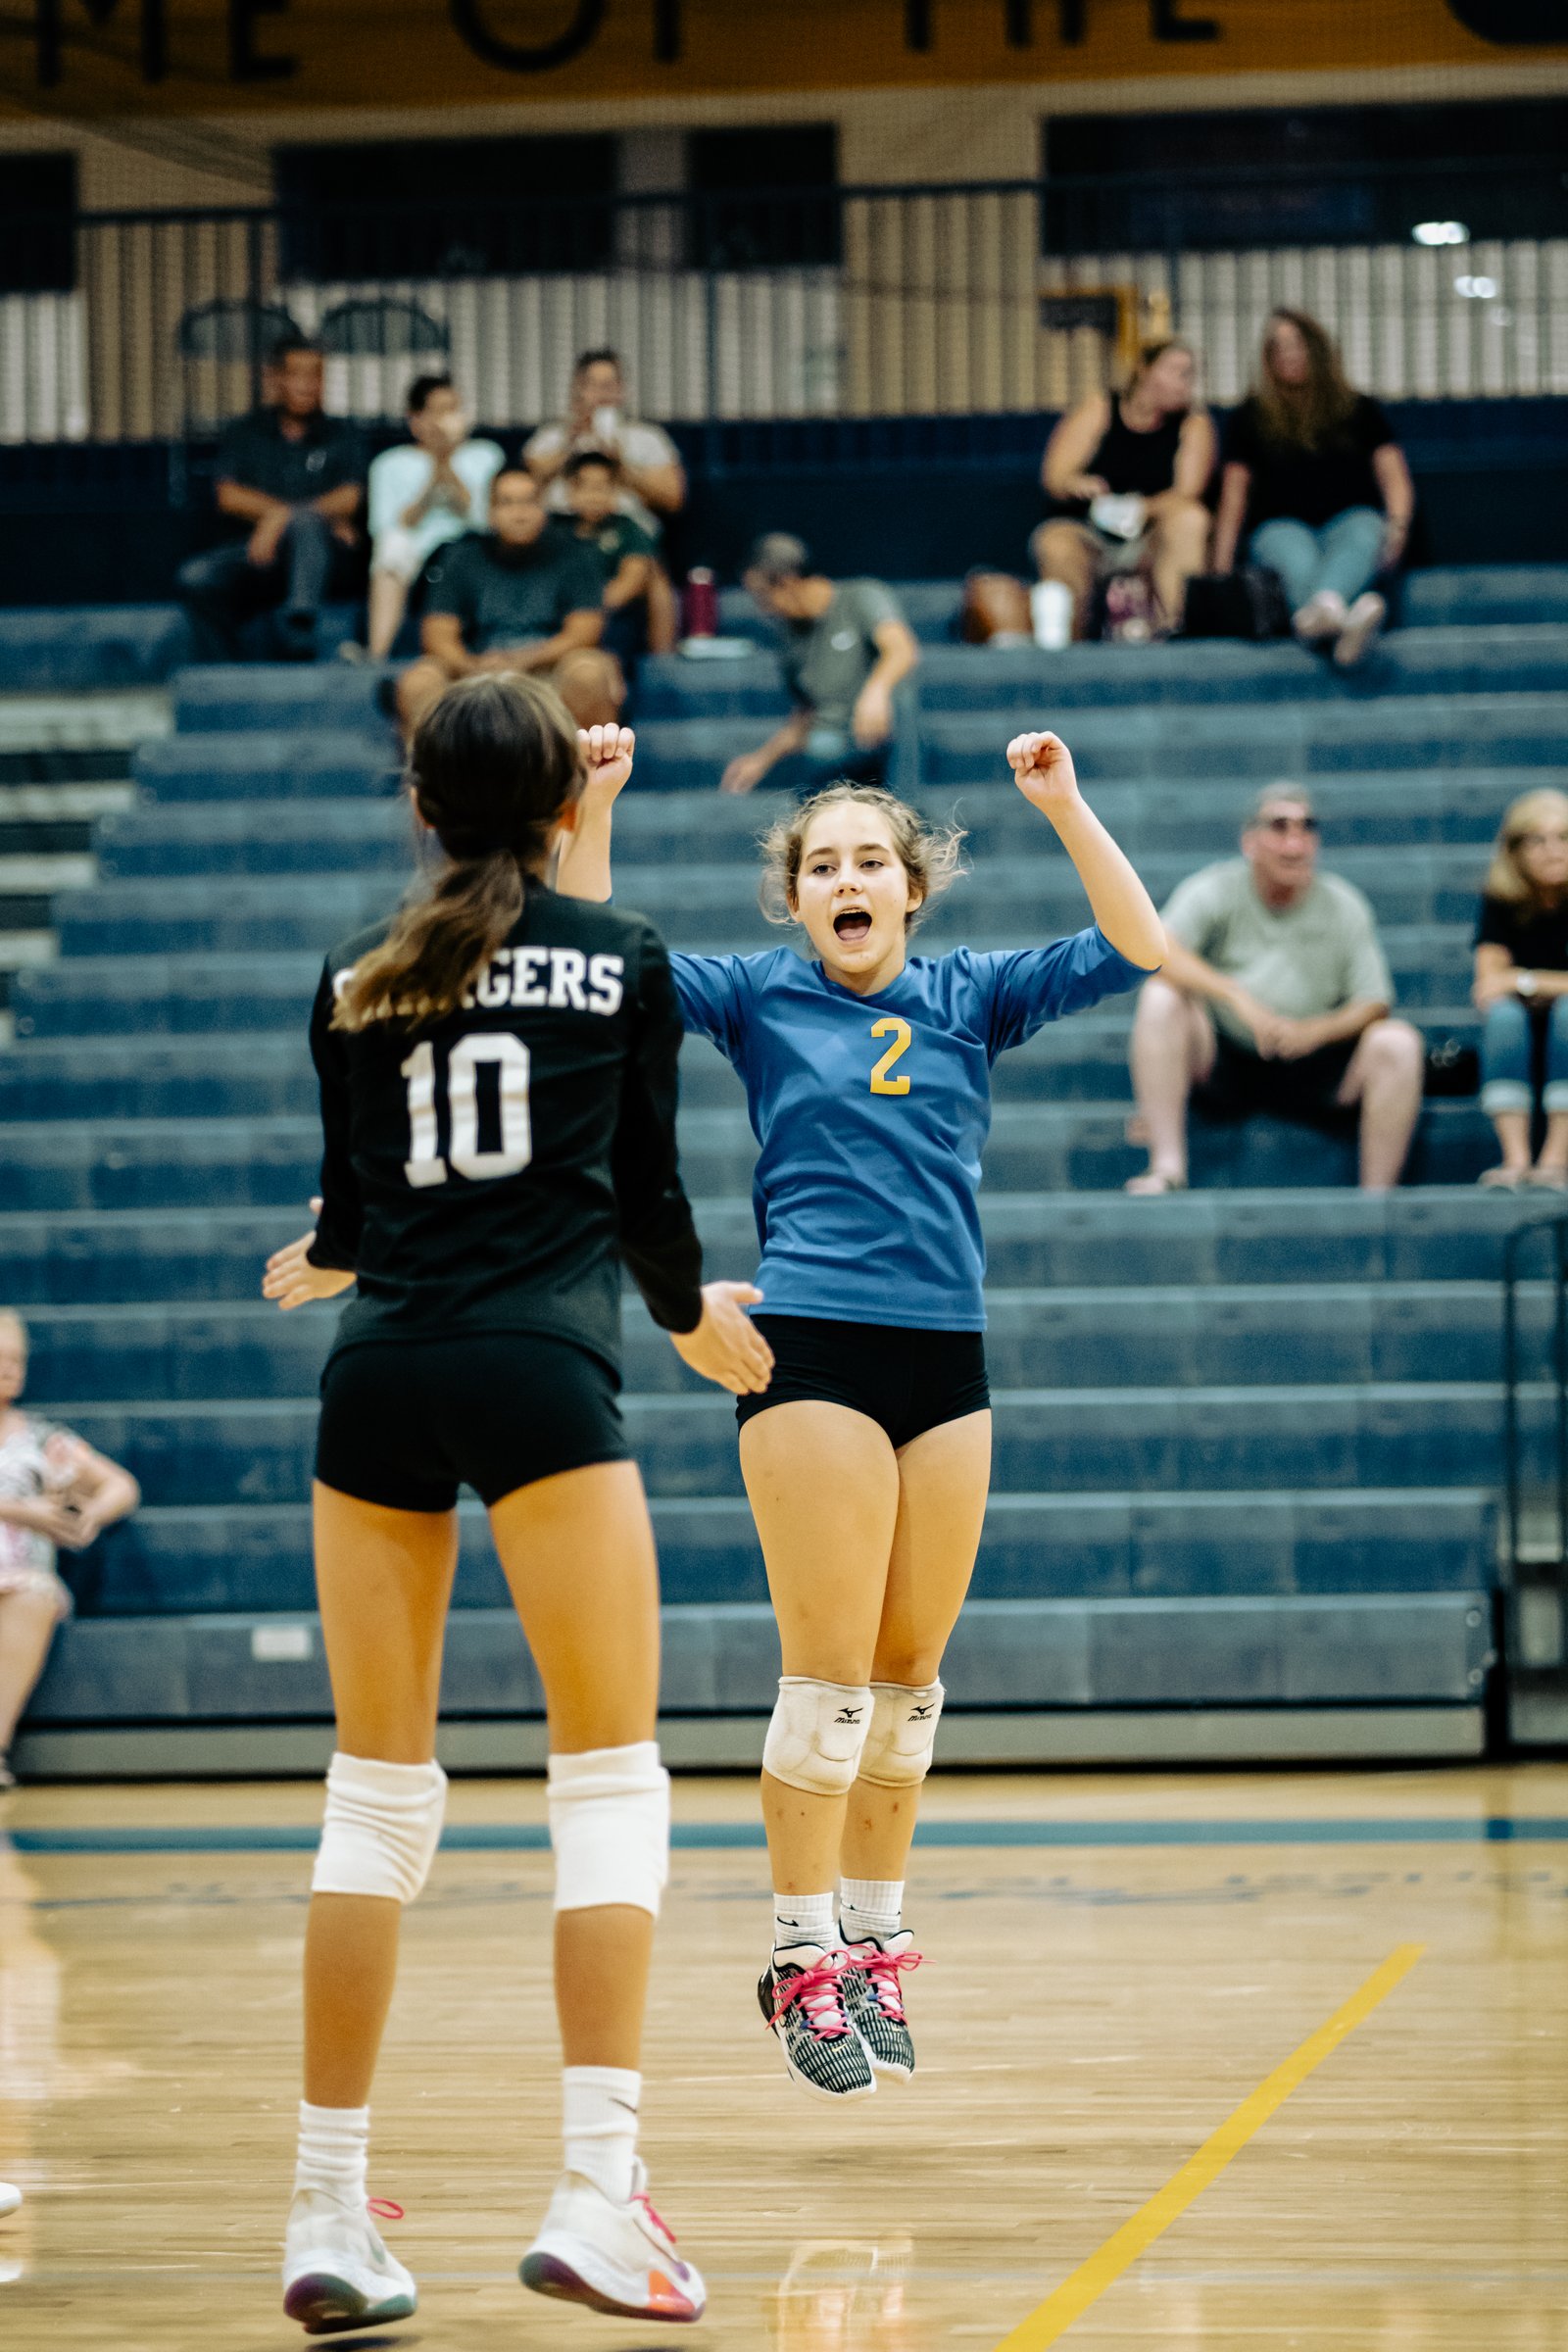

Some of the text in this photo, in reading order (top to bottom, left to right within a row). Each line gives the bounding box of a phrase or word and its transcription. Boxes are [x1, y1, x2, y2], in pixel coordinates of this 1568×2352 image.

[333, 945, 625, 1018] GERS
[870, 1017, 912, 1096] 2
[400, 1032, 532, 1189] 10
